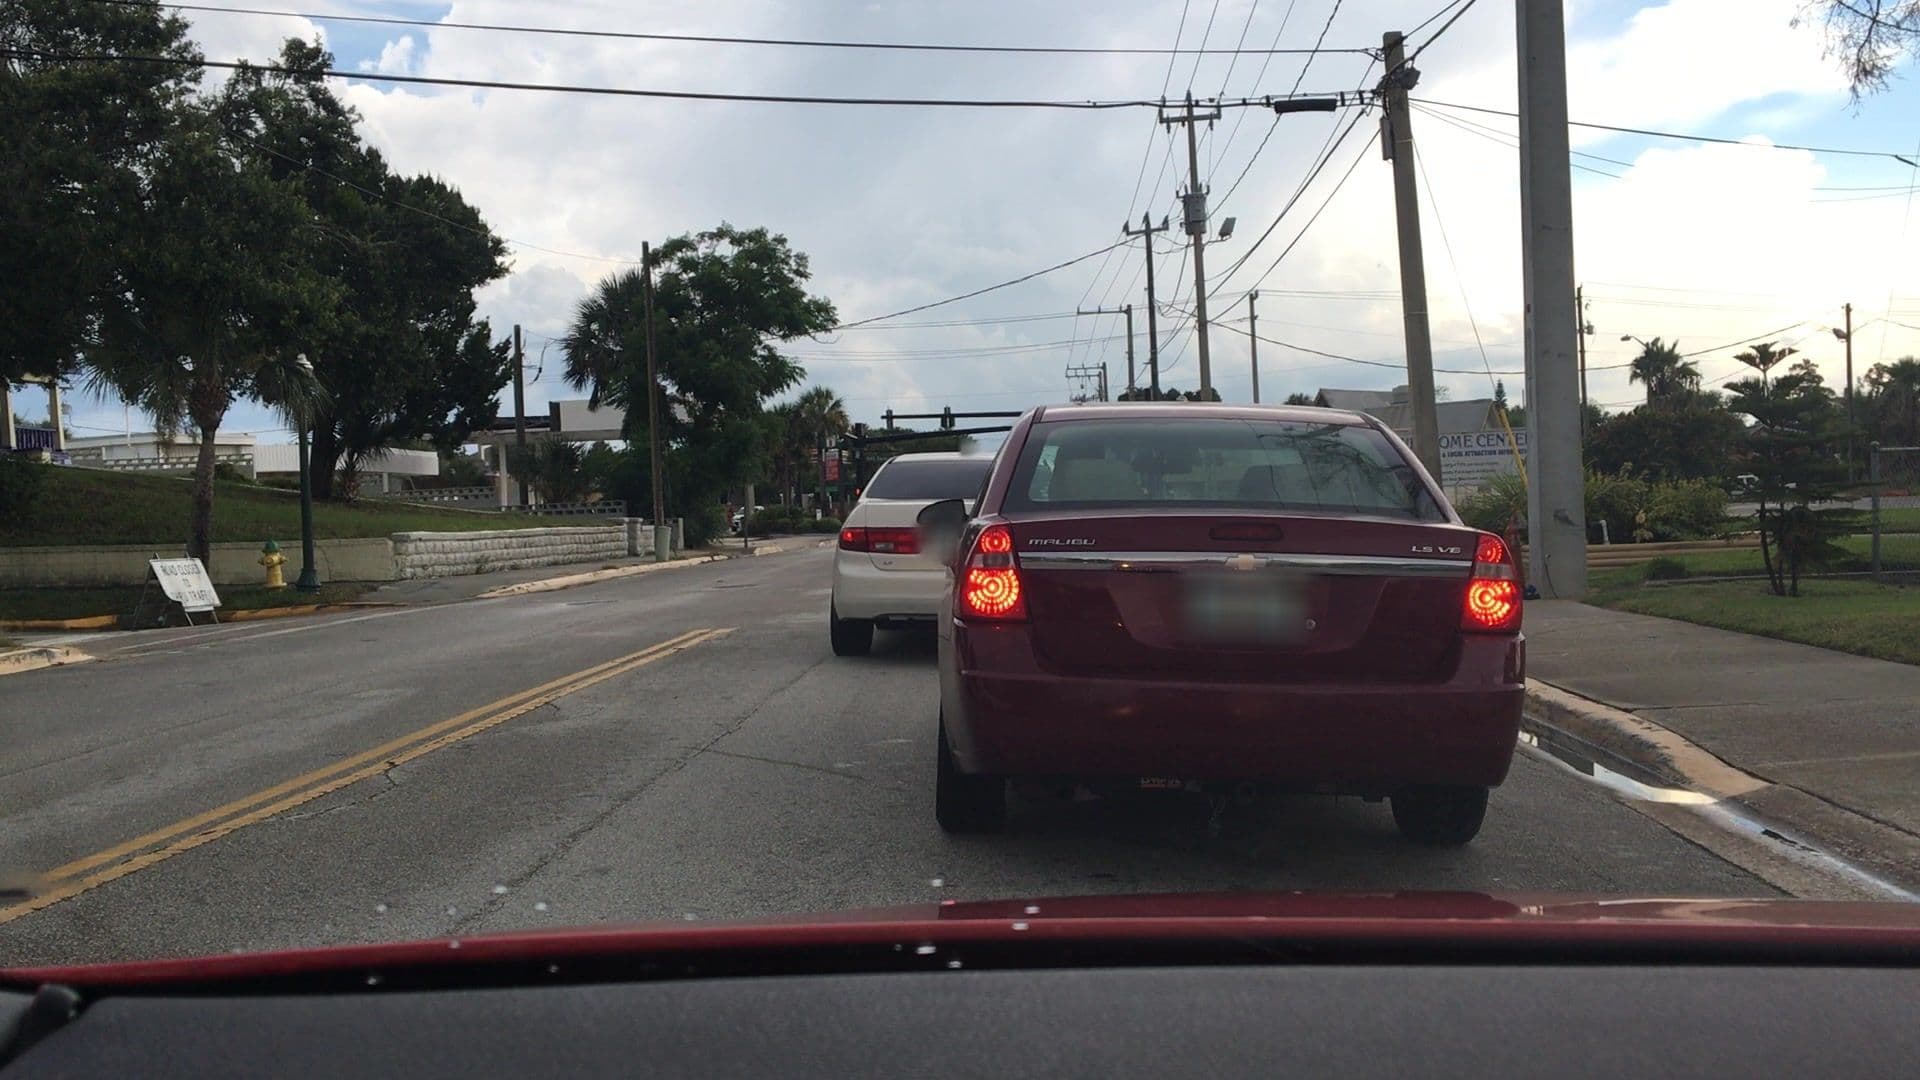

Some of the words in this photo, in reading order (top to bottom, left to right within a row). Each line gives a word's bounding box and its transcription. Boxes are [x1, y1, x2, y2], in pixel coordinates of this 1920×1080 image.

[1439, 434, 1474, 449] OME
[1028, 538, 1096, 546] MALIBU
[1412, 545, 1433, 553] LS
[1438, 546, 1461, 554] V6
